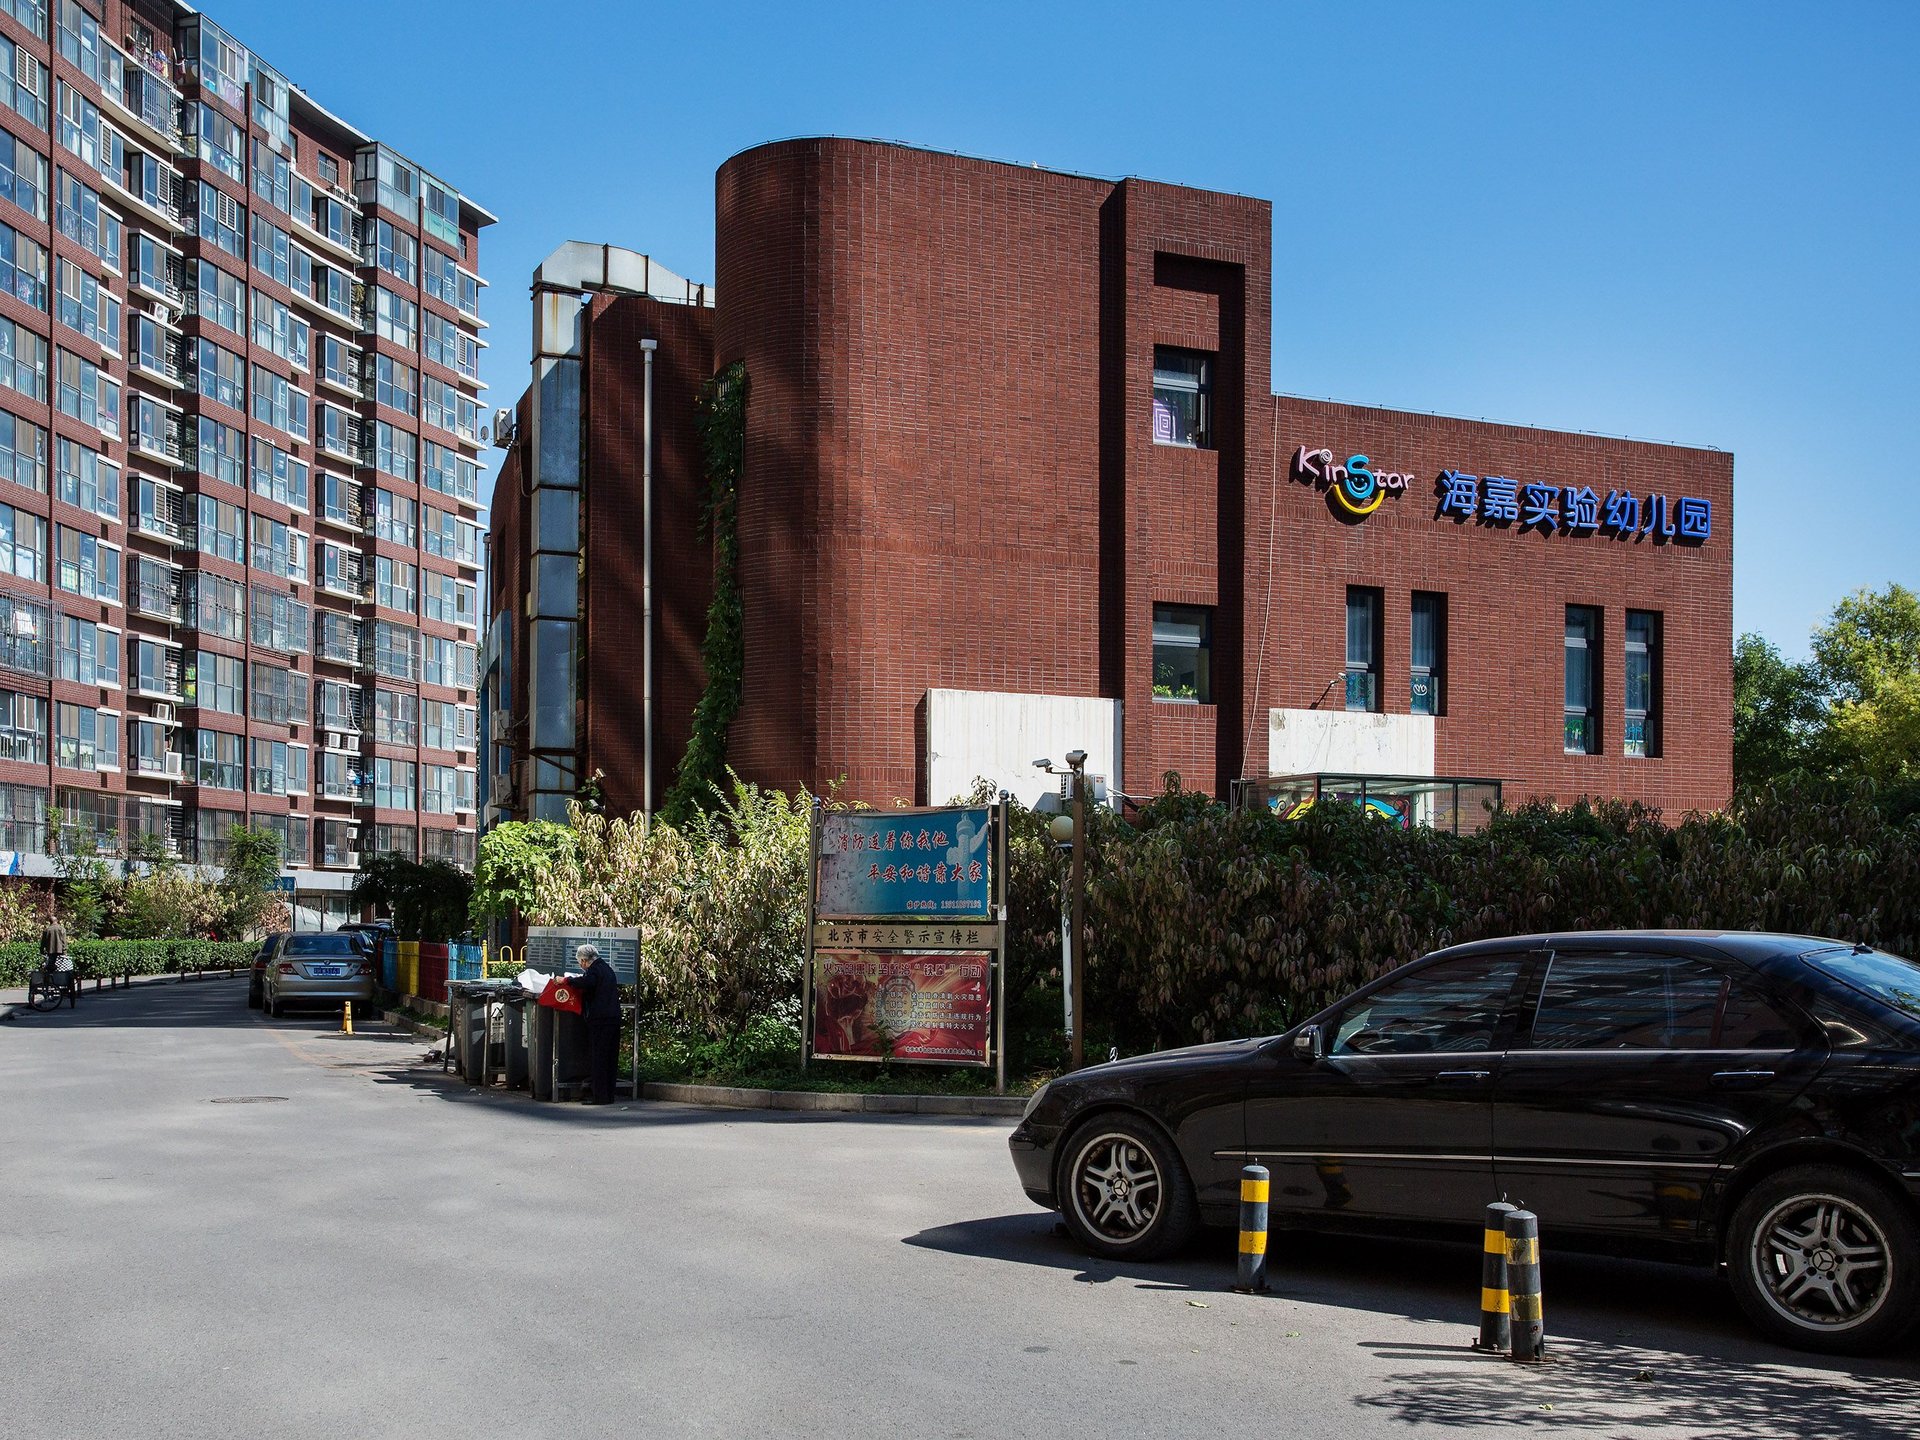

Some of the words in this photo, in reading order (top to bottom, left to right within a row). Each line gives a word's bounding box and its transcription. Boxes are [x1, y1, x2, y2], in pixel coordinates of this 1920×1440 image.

[1298, 445, 1415, 500] KinStar
[1442, 469, 1712, 539] 海嘉实验幼儿园
[837, 829, 950, 852] 消防连着你我他
[867, 860, 983, 884] 平安和谐靠大家
[827, 928, 980, 945] 北京市安全警示宣传栏
